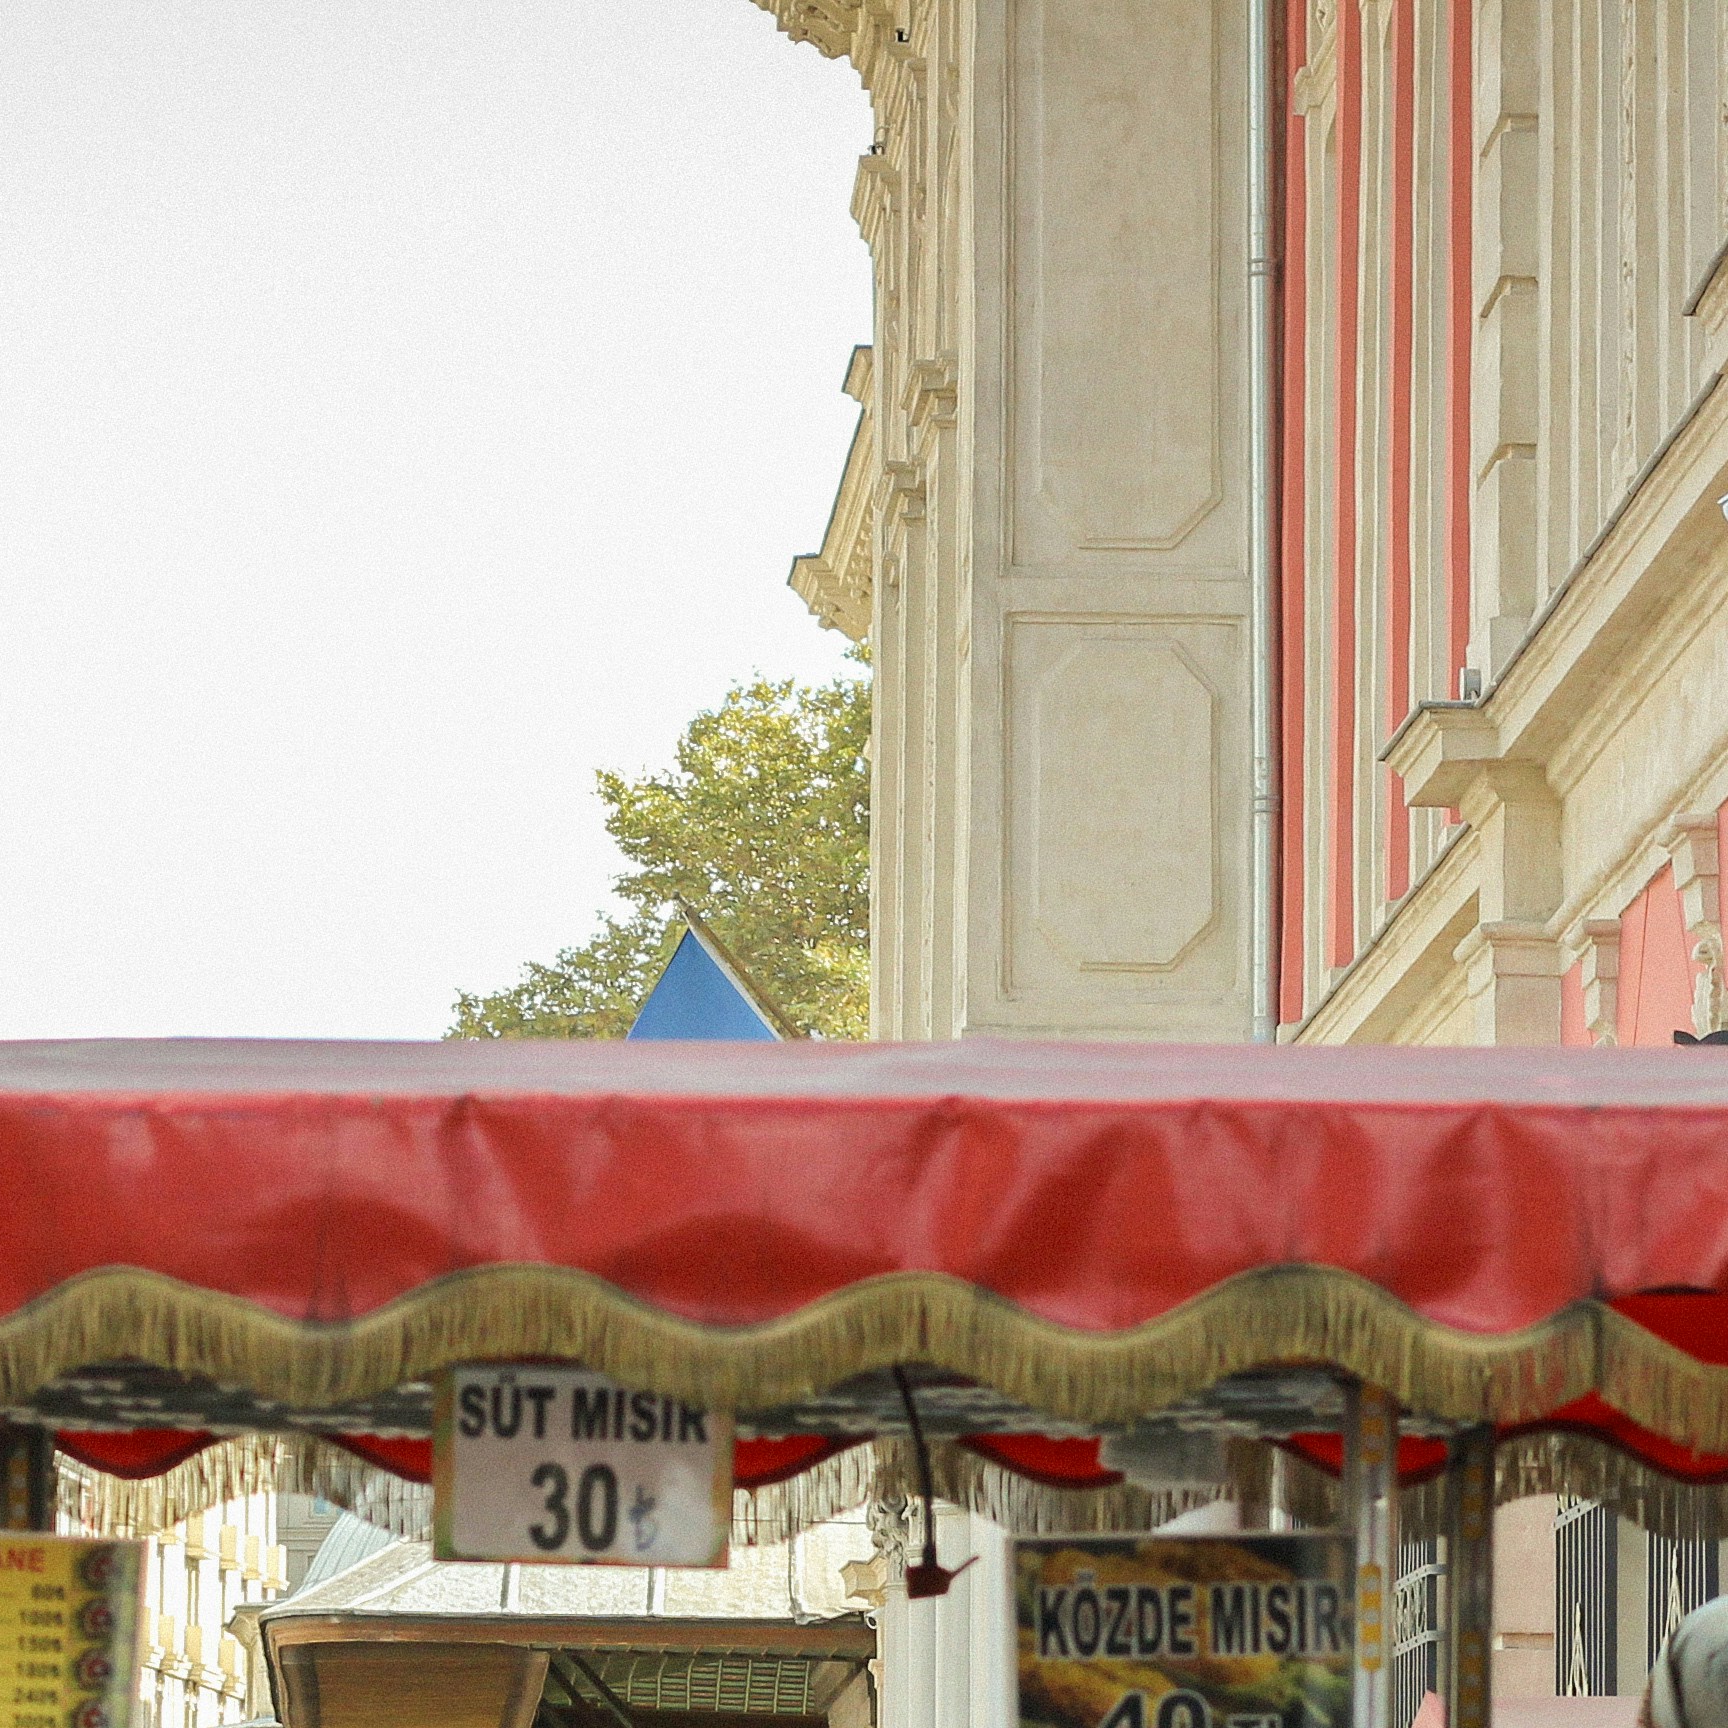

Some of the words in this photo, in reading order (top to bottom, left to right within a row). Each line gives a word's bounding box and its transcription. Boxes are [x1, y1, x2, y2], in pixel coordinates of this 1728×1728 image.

[459, 1372, 556, 1439] SÜT
[573, 1387, 709, 1444] MISIR
[529, 1462, 618, 1551] 30
[1037, 1570, 1199, 1660] KÖZDE
[1209, 1581, 1341, 1659] MISIR
